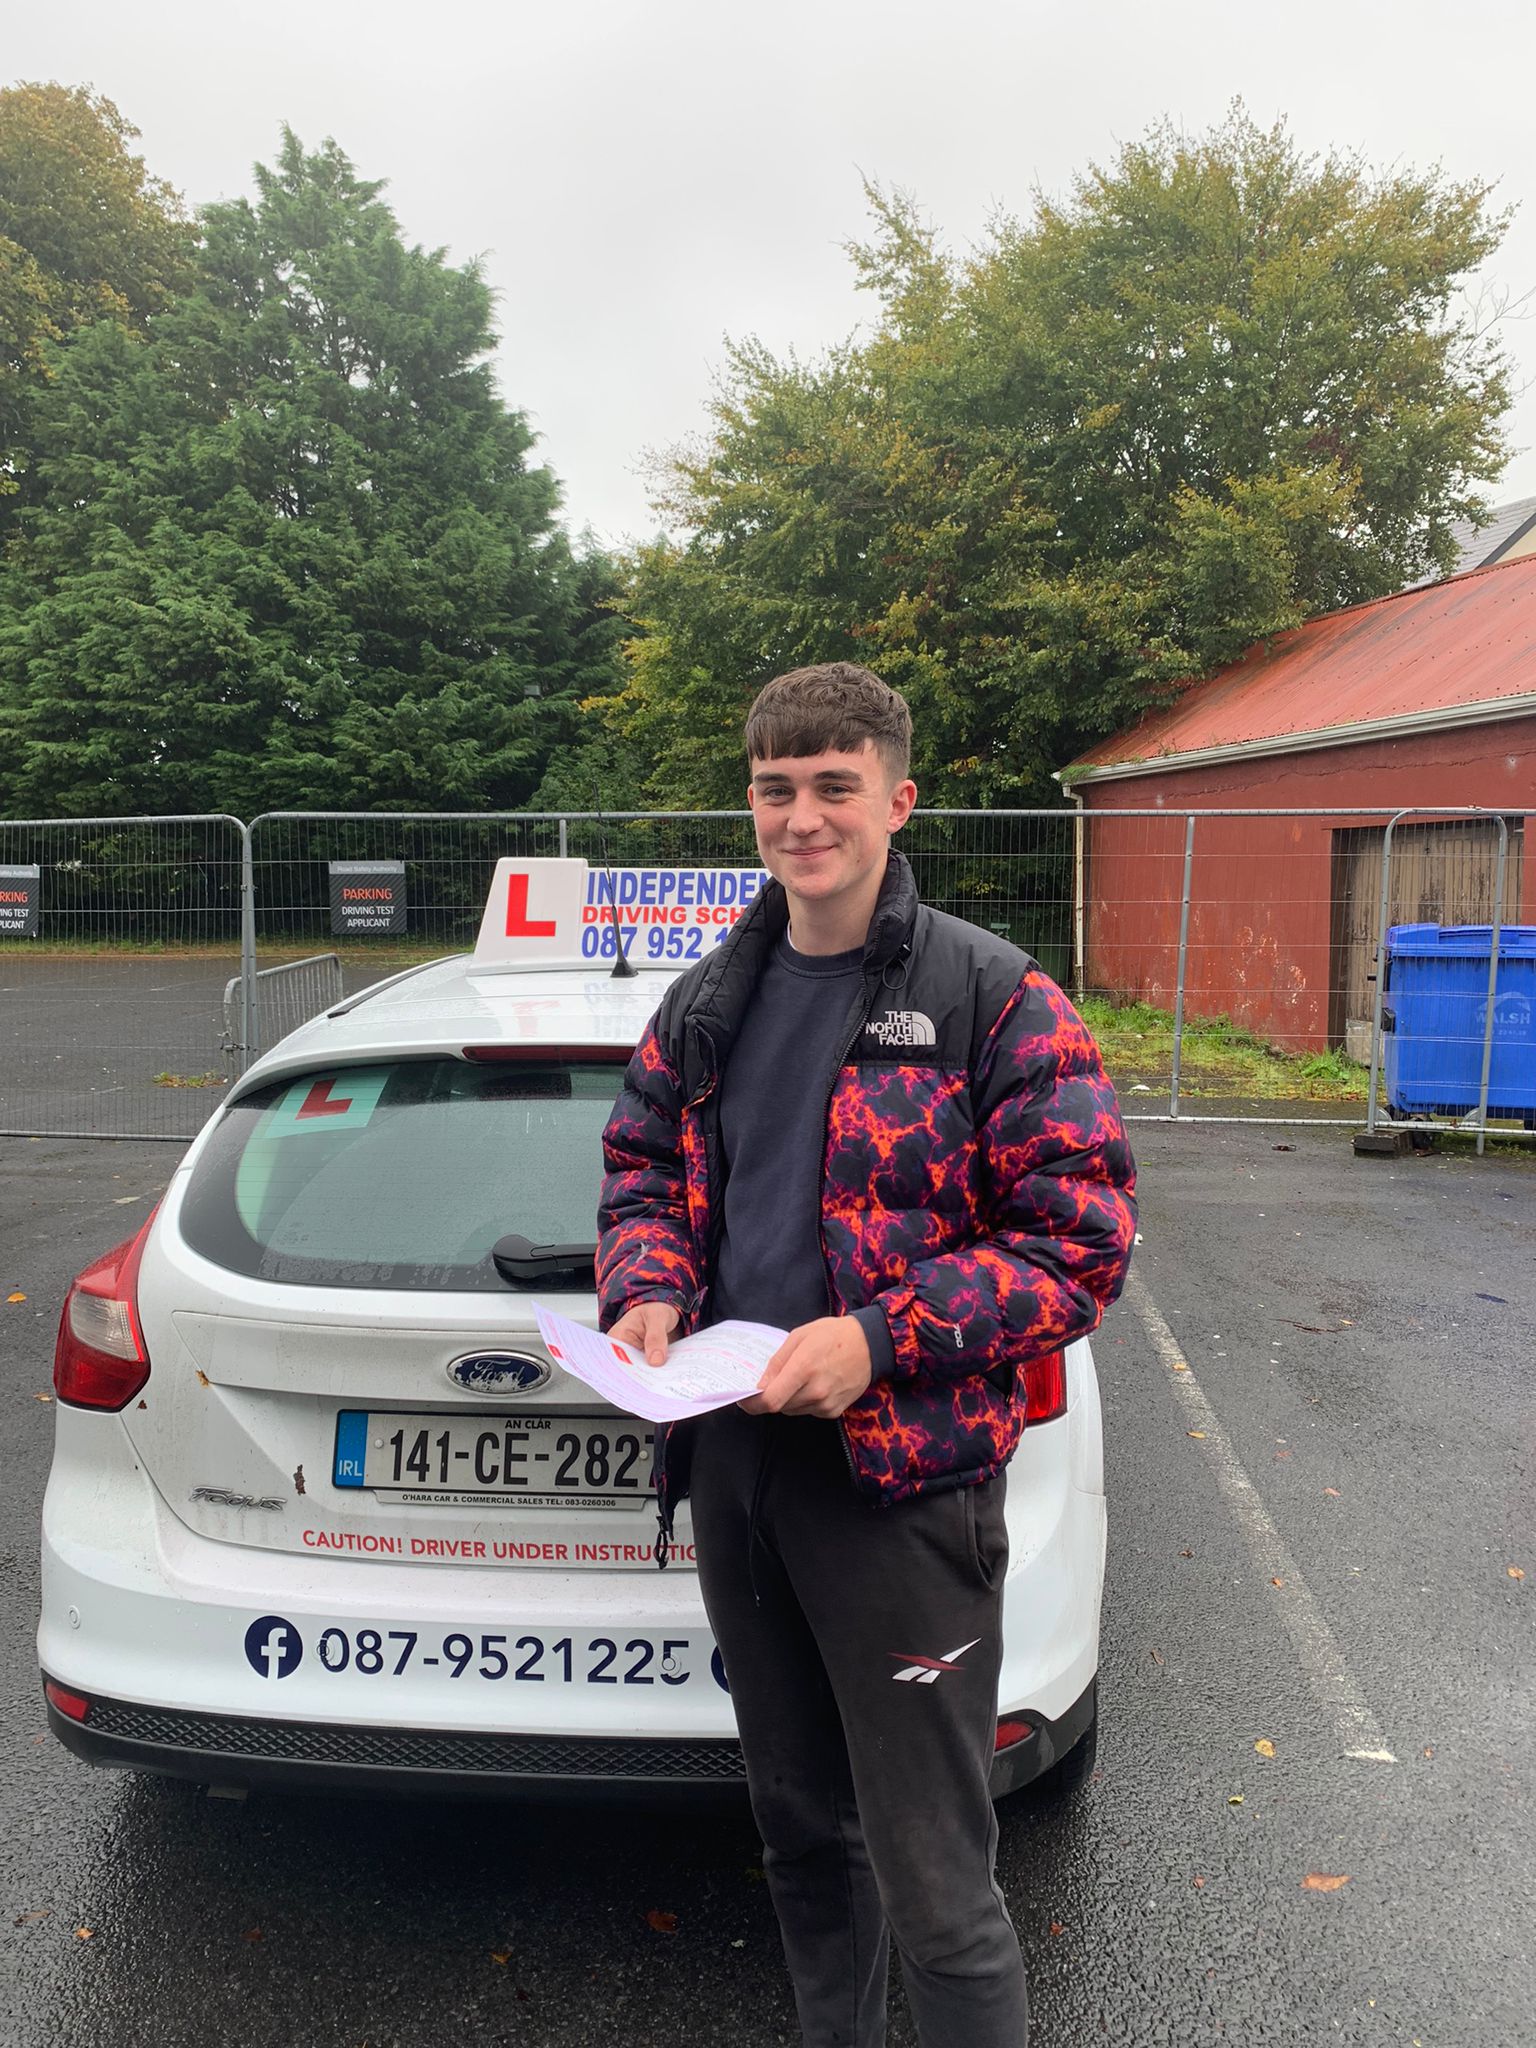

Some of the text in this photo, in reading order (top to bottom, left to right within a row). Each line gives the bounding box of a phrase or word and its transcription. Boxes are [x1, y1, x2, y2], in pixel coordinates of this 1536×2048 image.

[343, 888, 393, 900] PARKING
[586, 871, 768, 905] INDEPENDE
[0, 891, 28, 903] RKING
[505, 873, 556, 937] L
[0, 908, 29, 918] ING TEST
[341, 905, 395, 915] DRIVING TEST
[582, 906, 687, 924] DRIVING
[346, 918, 391, 928] APPLICANT
[581, 926, 638, 959] 087
[647, 926, 702, 959] 952
[884, 1011, 912, 1022] THE
[865, 1022, 912, 1034] NORTH
[879, 1034, 913, 1046] FACE
[294, 1078, 353, 1121] L
[953, 1323, 964, 1349] 700
[468, 1359, 526, 1384] Ford
[504, 1417, 551, 1430] AN CLÁR
[338, 1459, 363, 1477] IRL
[402, 1493, 432, 1503] O'HARA
[434, 1495, 451, 1503] CAR
[461, 1496, 515, 1505] COMMERCIAL
[517, 1497, 543, 1506] SALES
[545, 1498, 564, 1506] TEL:
[565, 1498, 616, 1508] 083-0260306
[303, 1529, 402, 1554] CAUTION!
[411, 1538, 486, 1558] DRIVER
[493, 1541, 568, 1561] UNDER
[318, 1627, 691, 1686] 087-9521225
